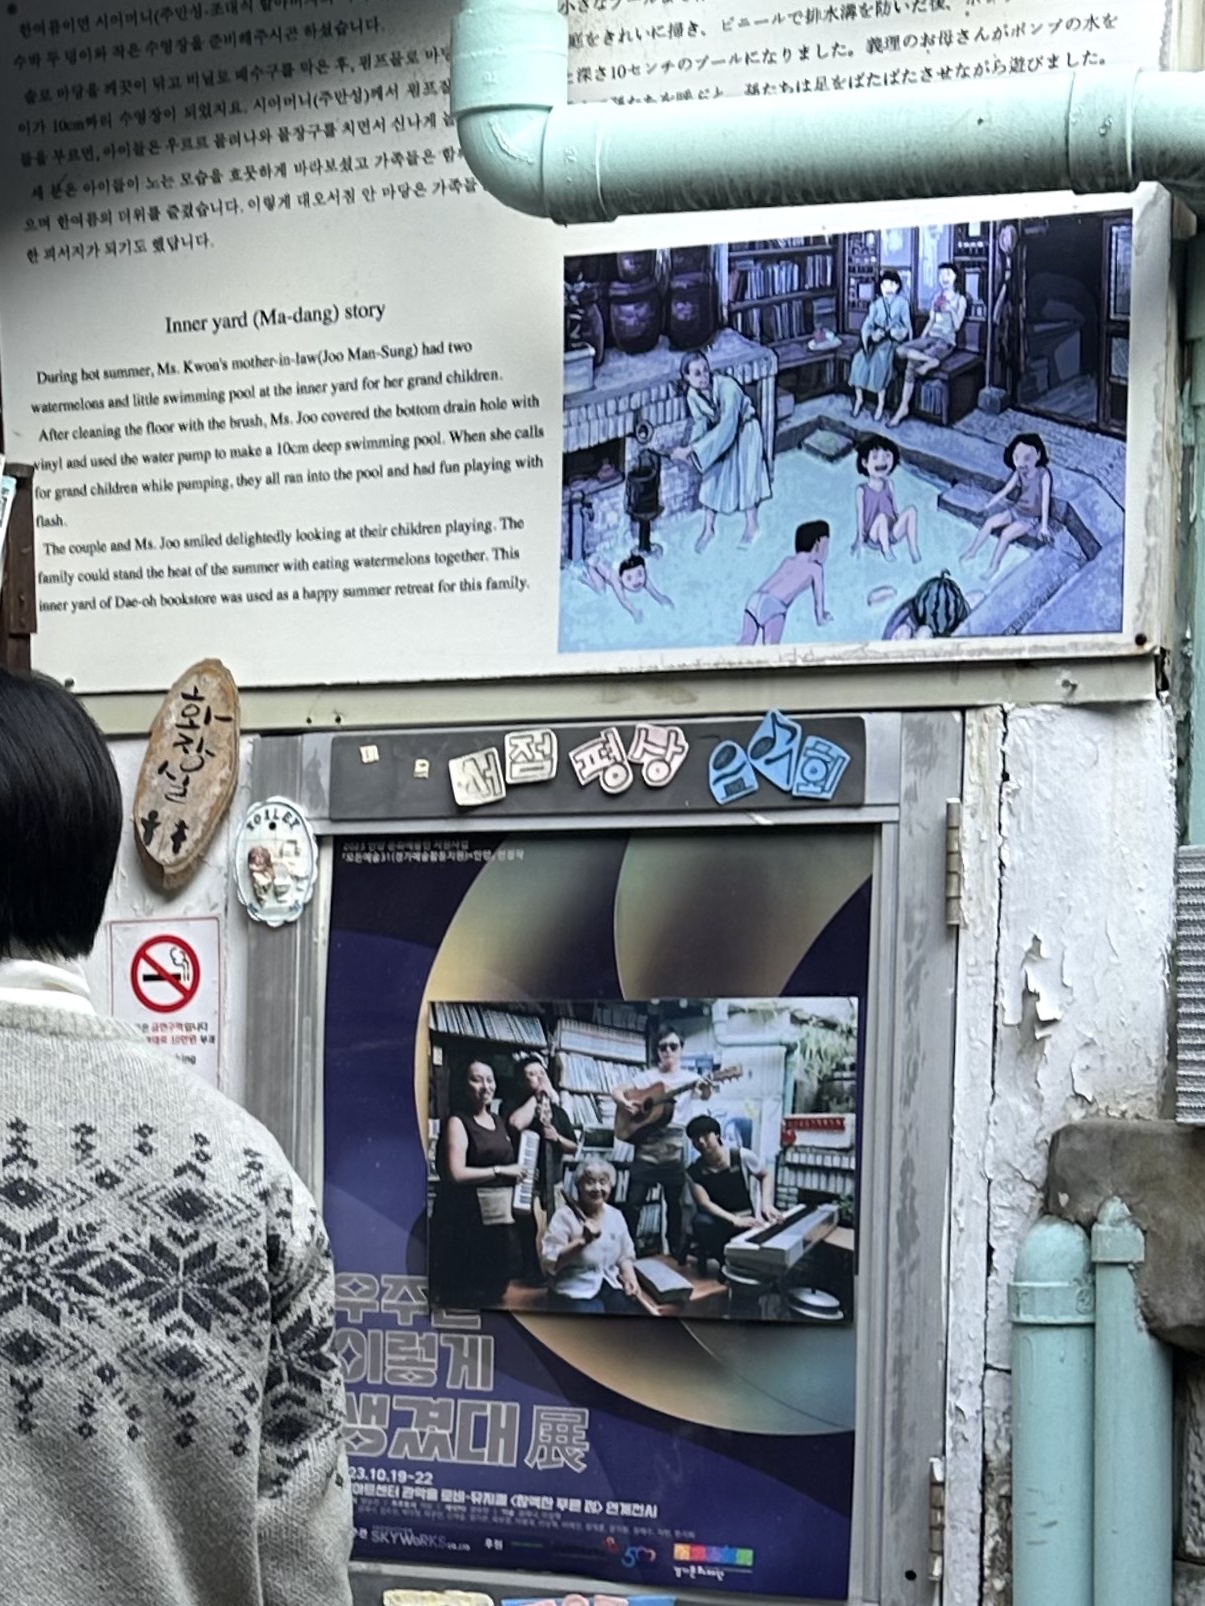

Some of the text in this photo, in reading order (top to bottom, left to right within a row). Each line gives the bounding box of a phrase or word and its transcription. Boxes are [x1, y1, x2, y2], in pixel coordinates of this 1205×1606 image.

[432, 178, 481, 196] 가족들
[166, 304, 385, 335] Inner yard (Ma-dang) story
[37, 370, 78, 386] During
[103, 366, 154, 380] summer,
[157, 362, 179, 376] Ms.
[183, 358, 228, 374] Kwon's
[422, 341, 444, 356] had
[448, 342, 472, 354] two
[31, 368, 503, 414] watermelons and little swimming pool at the inner yard for her grand children.
[39, 394, 539, 442] After cleaning the floor with the brush, Ms. Joo covered the bottom drain hole with
[67, 455, 87, 469] and
[90, 453, 117, 467] used
[121, 452, 138, 466] the
[142, 452, 174, 464] water
[177, 450, 211, 465] pump
[215, 448, 226, 460] to
[230, 444, 262, 459] make
[265, 446, 272, 456] a
[277, 442, 309, 455] 10cm
[313, 439, 341, 456] deep
[345, 434, 410, 451] swimming
[413, 431, 445, 450] pool.
[449, 430, 486, 444] When
[490, 427, 511, 441] she
[515, 424, 544, 440] calls
[35, 482, 52, 499] for
[55, 484, 87, 502] grand
[90, 482, 138, 496] children
[141, 478, 173, 492] while
[236, 474, 261, 489] they
[265, 472, 280, 485] all
[284, 474, 303, 484] ran
[307, 469, 331, 482] into
[333, 467, 353, 481] the
[356, 464, 383, 483] pool
[387, 463, 409, 477] and
[413, 461, 435, 476] had
[440, 460, 460, 474] fun
[464, 457, 511, 476] playing
[515, 454, 543, 468] with
[43, 516, 524, 556] The couple and Ms. Joo smiled delightedly looking at their children playing. The
[39, 576, 529, 614] inner yard of Dae-oh bookstore was used as a happy summer retreat for this family.
[157, 686, 233, 803] 화장실
[457, 731, 553, 798] 서점
[574, 727, 686, 791] 평상
[246, 808, 300, 832] TOILET
[335, 1327, 494, 1391] 이렇게
[524, 1404, 590, 1473] 展
